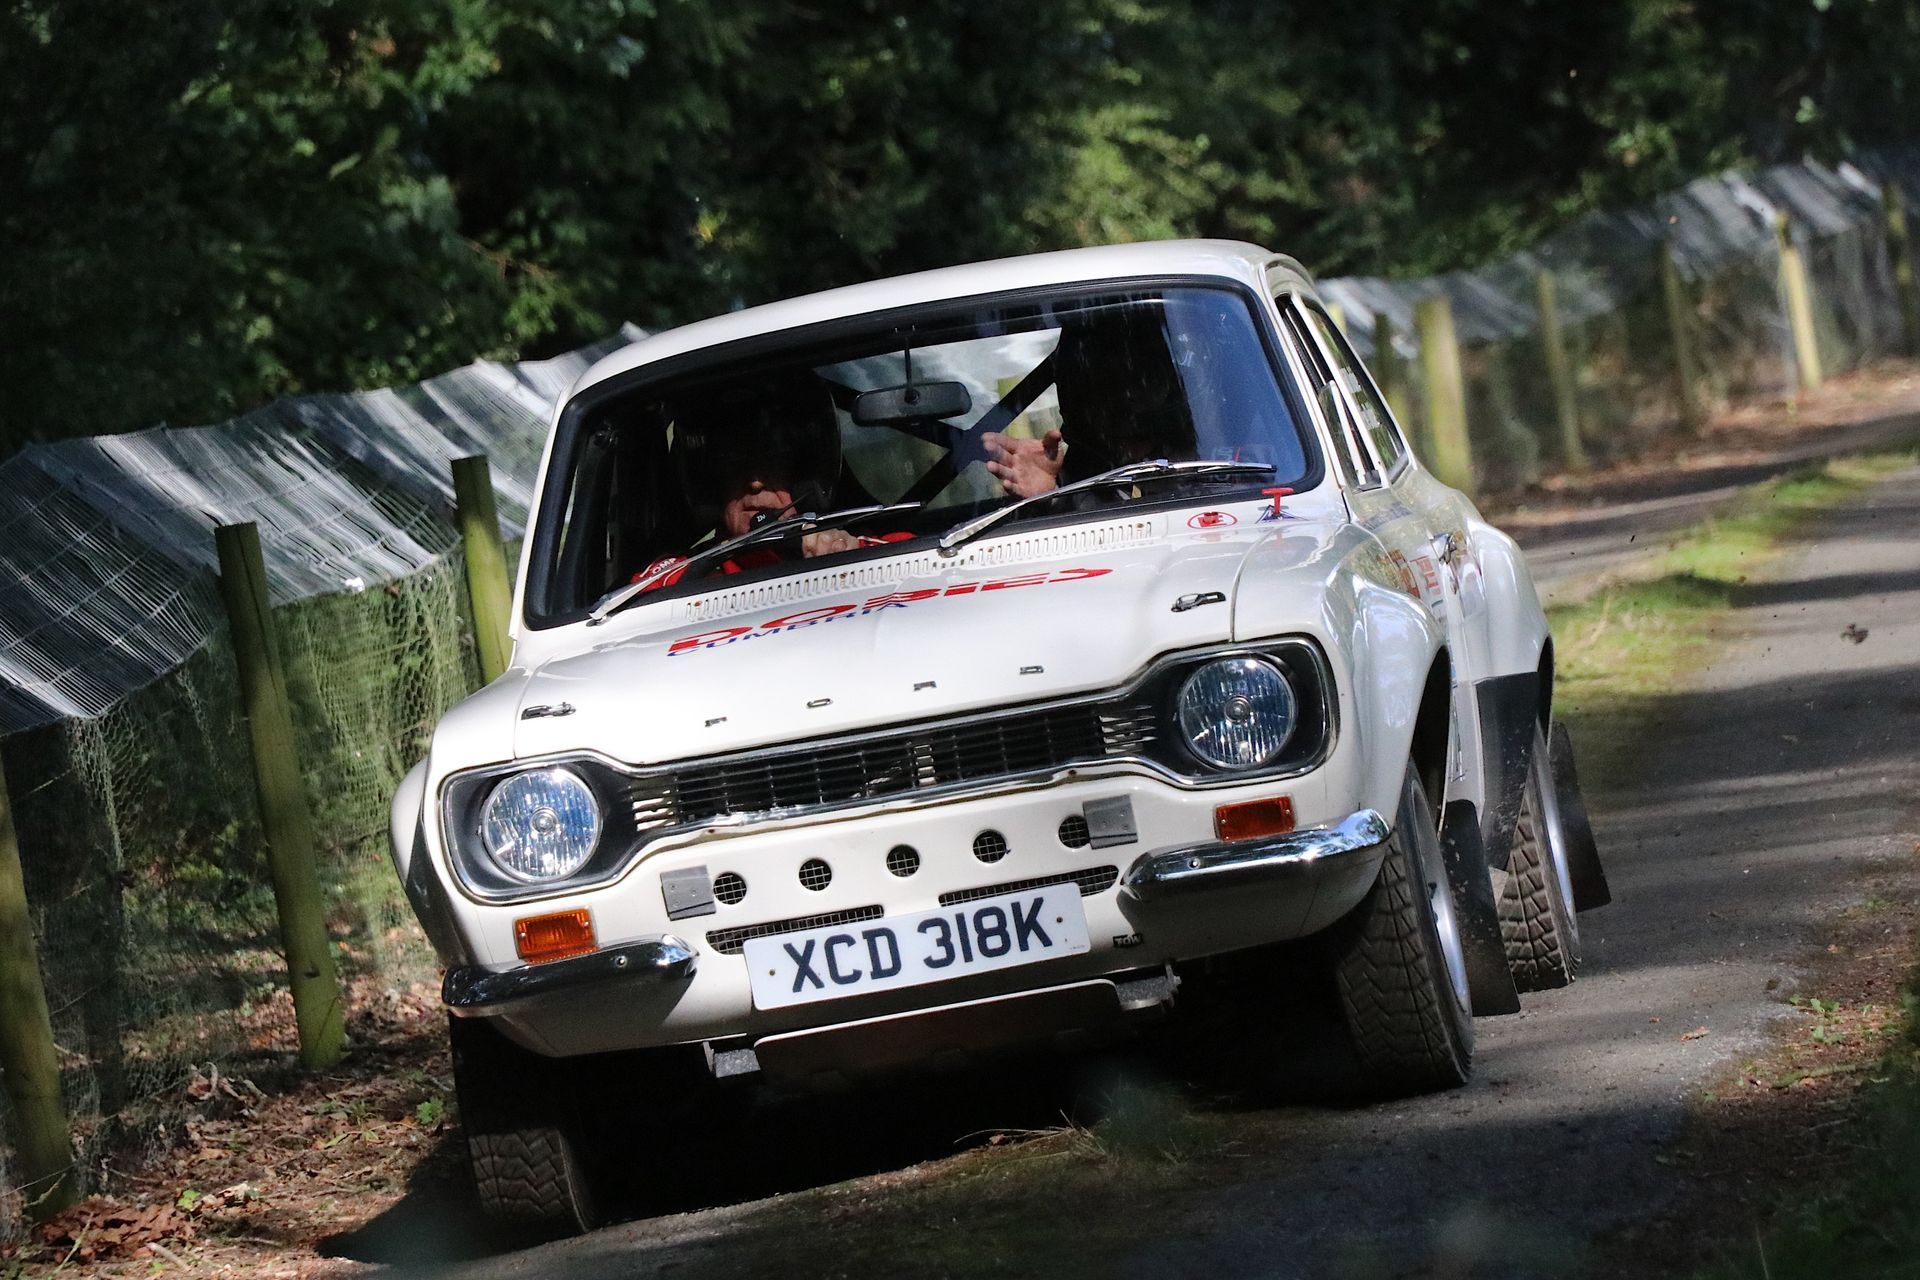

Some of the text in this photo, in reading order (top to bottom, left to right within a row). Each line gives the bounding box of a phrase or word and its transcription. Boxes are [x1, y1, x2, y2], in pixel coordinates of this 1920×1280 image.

[651, 557, 677, 574] OMP
[666, 601, 908, 657] CUMBRIA
[704, 664, 1045, 728] FORD
[783, 896, 1053, 993] XCD 318K
[1114, 934, 1142, 946] TOW
